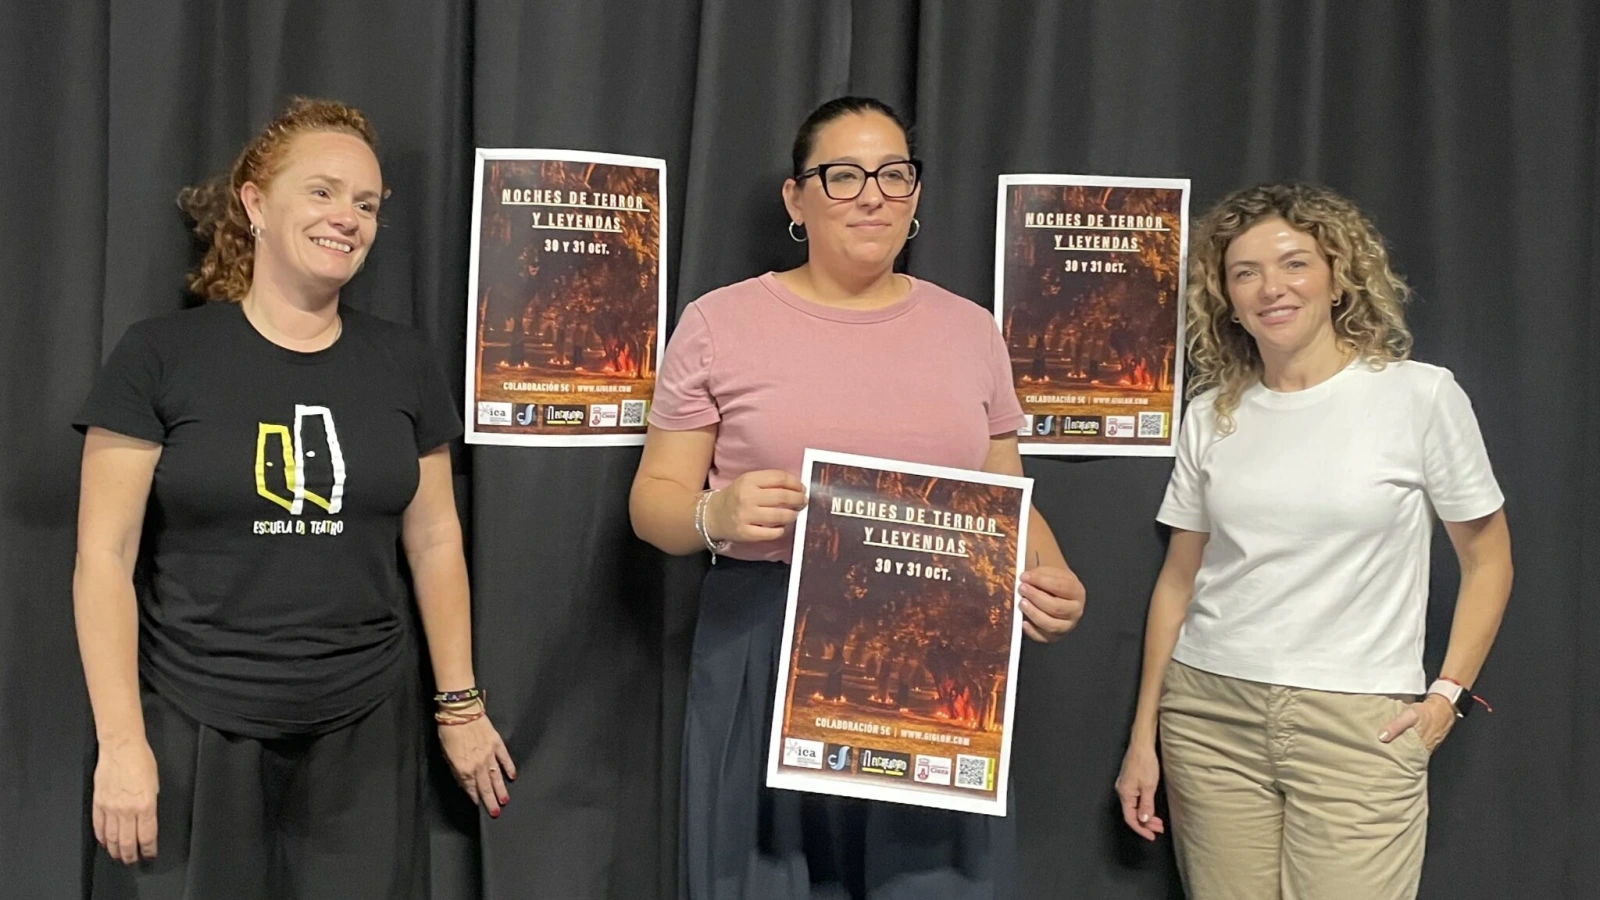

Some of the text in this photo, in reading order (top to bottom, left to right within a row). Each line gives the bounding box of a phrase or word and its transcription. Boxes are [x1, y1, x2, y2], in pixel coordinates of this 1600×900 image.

[502, 189, 643, 209] NOCHES DE TERROR
[532, 212, 621, 230] Y LEYENDAS
[1025, 212, 1163, 229] NOCHES DE TERROR
[544, 239, 610, 255] 30 Y 31 OCT.
[1054, 235, 1138, 249] Y LEYENDAS
[1064, 260, 1127, 273] 30 Y 31 OCT.
[503, 381, 559, 392] COLABORACIÓN
[490, 408, 505, 417] ica
[831, 497, 997, 533] NOCHES DE TERROR
[253, 520, 292, 535] ESCUELA
[310, 520, 344, 536] TEATRO
[864, 526, 966, 554] Y LEYENDAS
[875, 558, 952, 581] 30 Y 31 OCT.
[815, 717, 879, 734] COLABORACIÓN
[797, 746, 816, 758] ica
